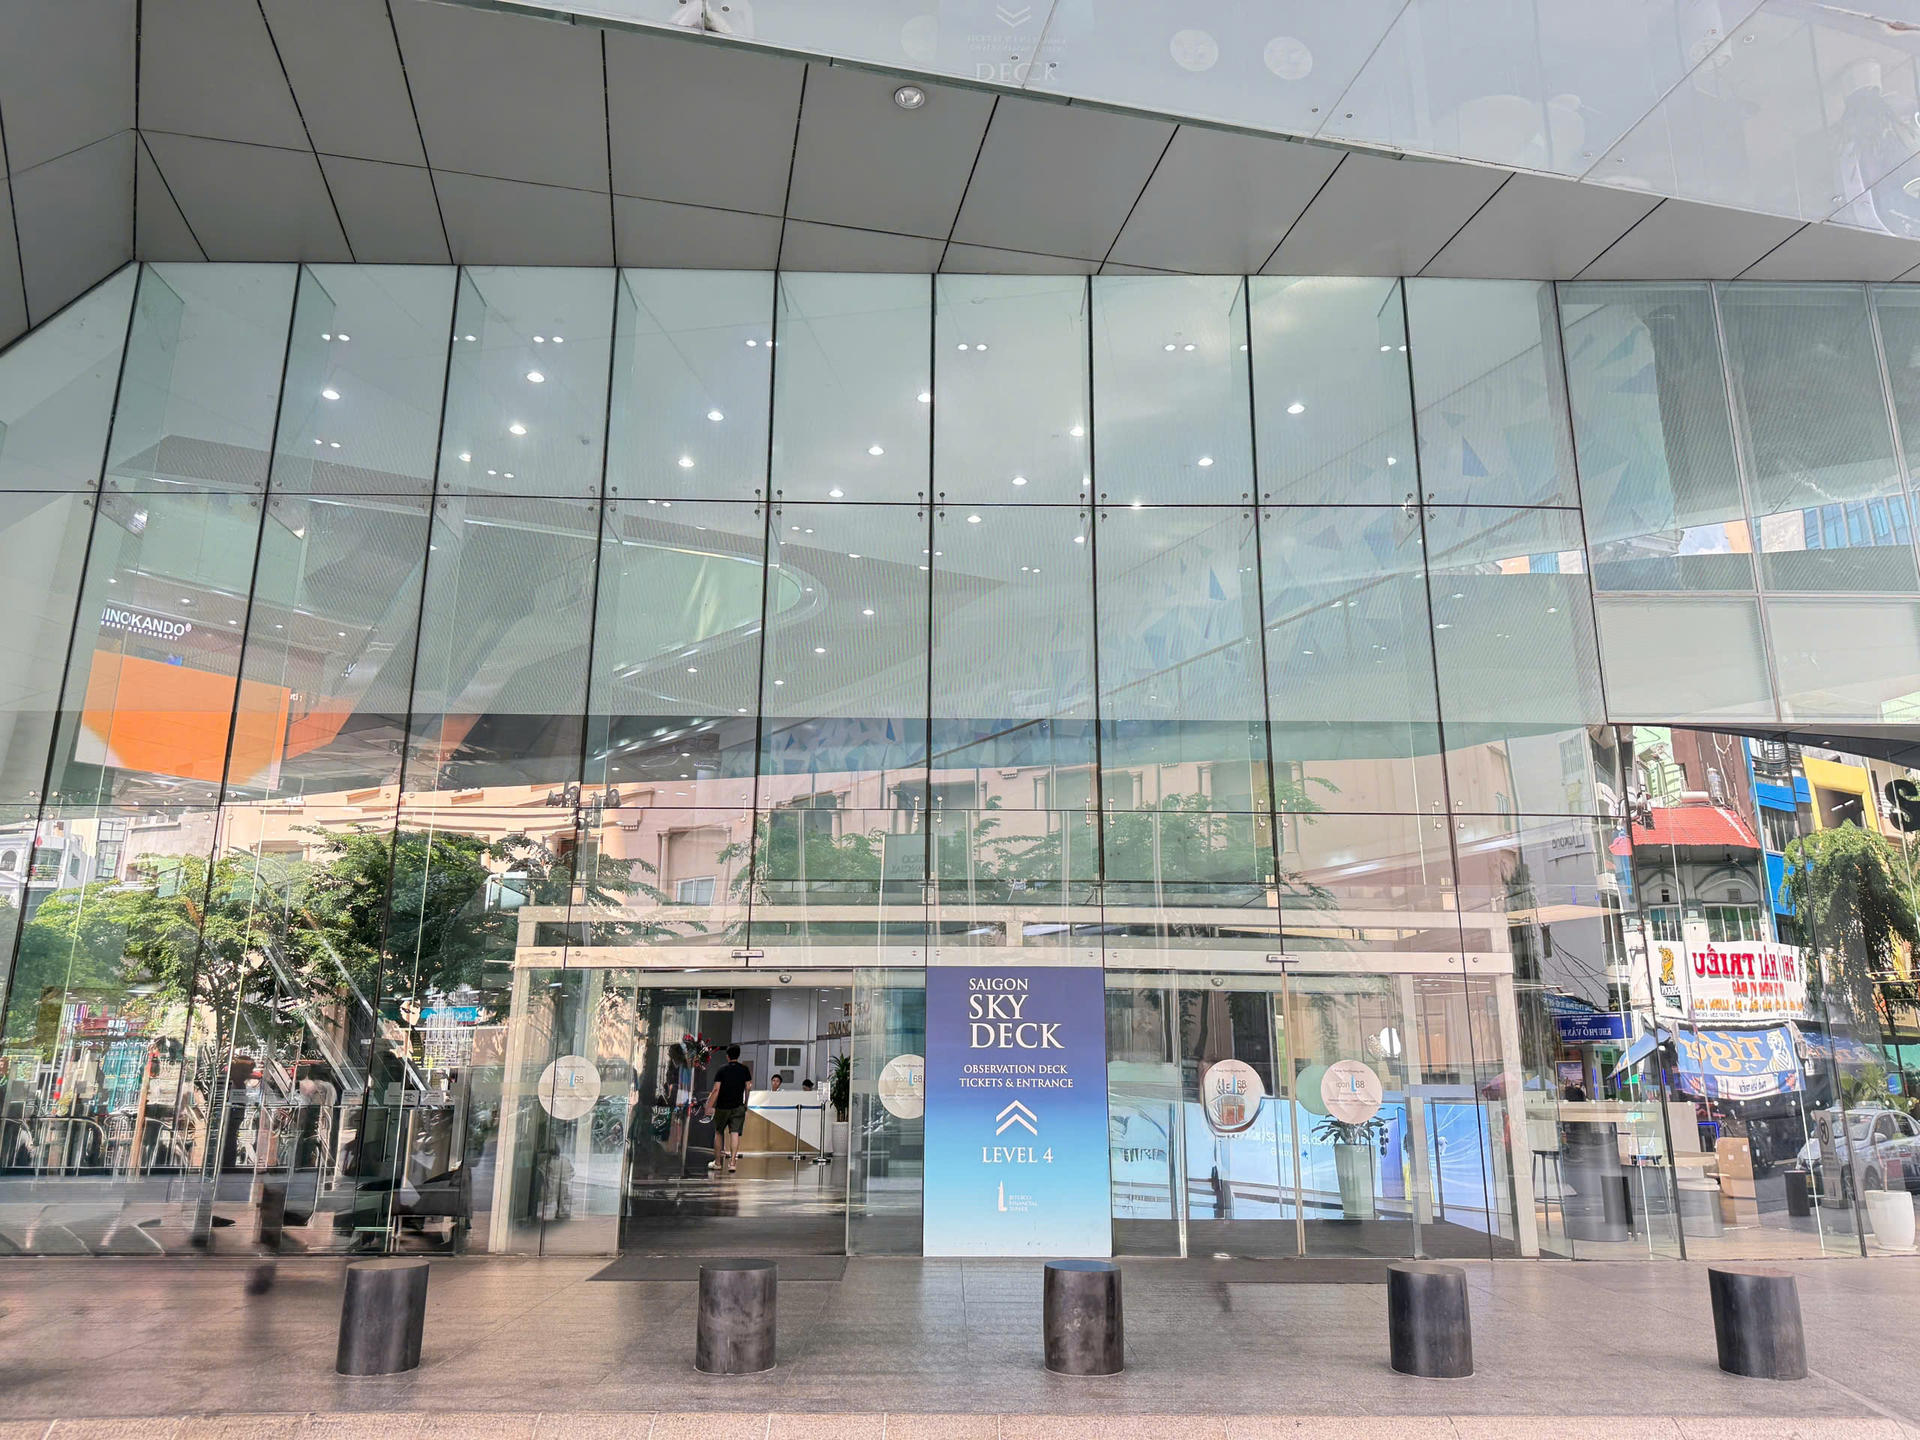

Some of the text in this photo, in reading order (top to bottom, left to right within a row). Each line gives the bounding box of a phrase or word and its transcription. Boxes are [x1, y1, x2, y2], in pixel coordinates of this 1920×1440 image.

[968, 978, 1029, 991] SAIGON
[968, 994, 1029, 1019] SKY
[970, 1023, 1065, 1049] DECK
[963, 1064, 1068, 1075] OBSERVATION DECK
[959, 1078, 1074, 1089] TICKETS & ENTRANCE
[982, 1147, 1053, 1163] LEVEL 4
